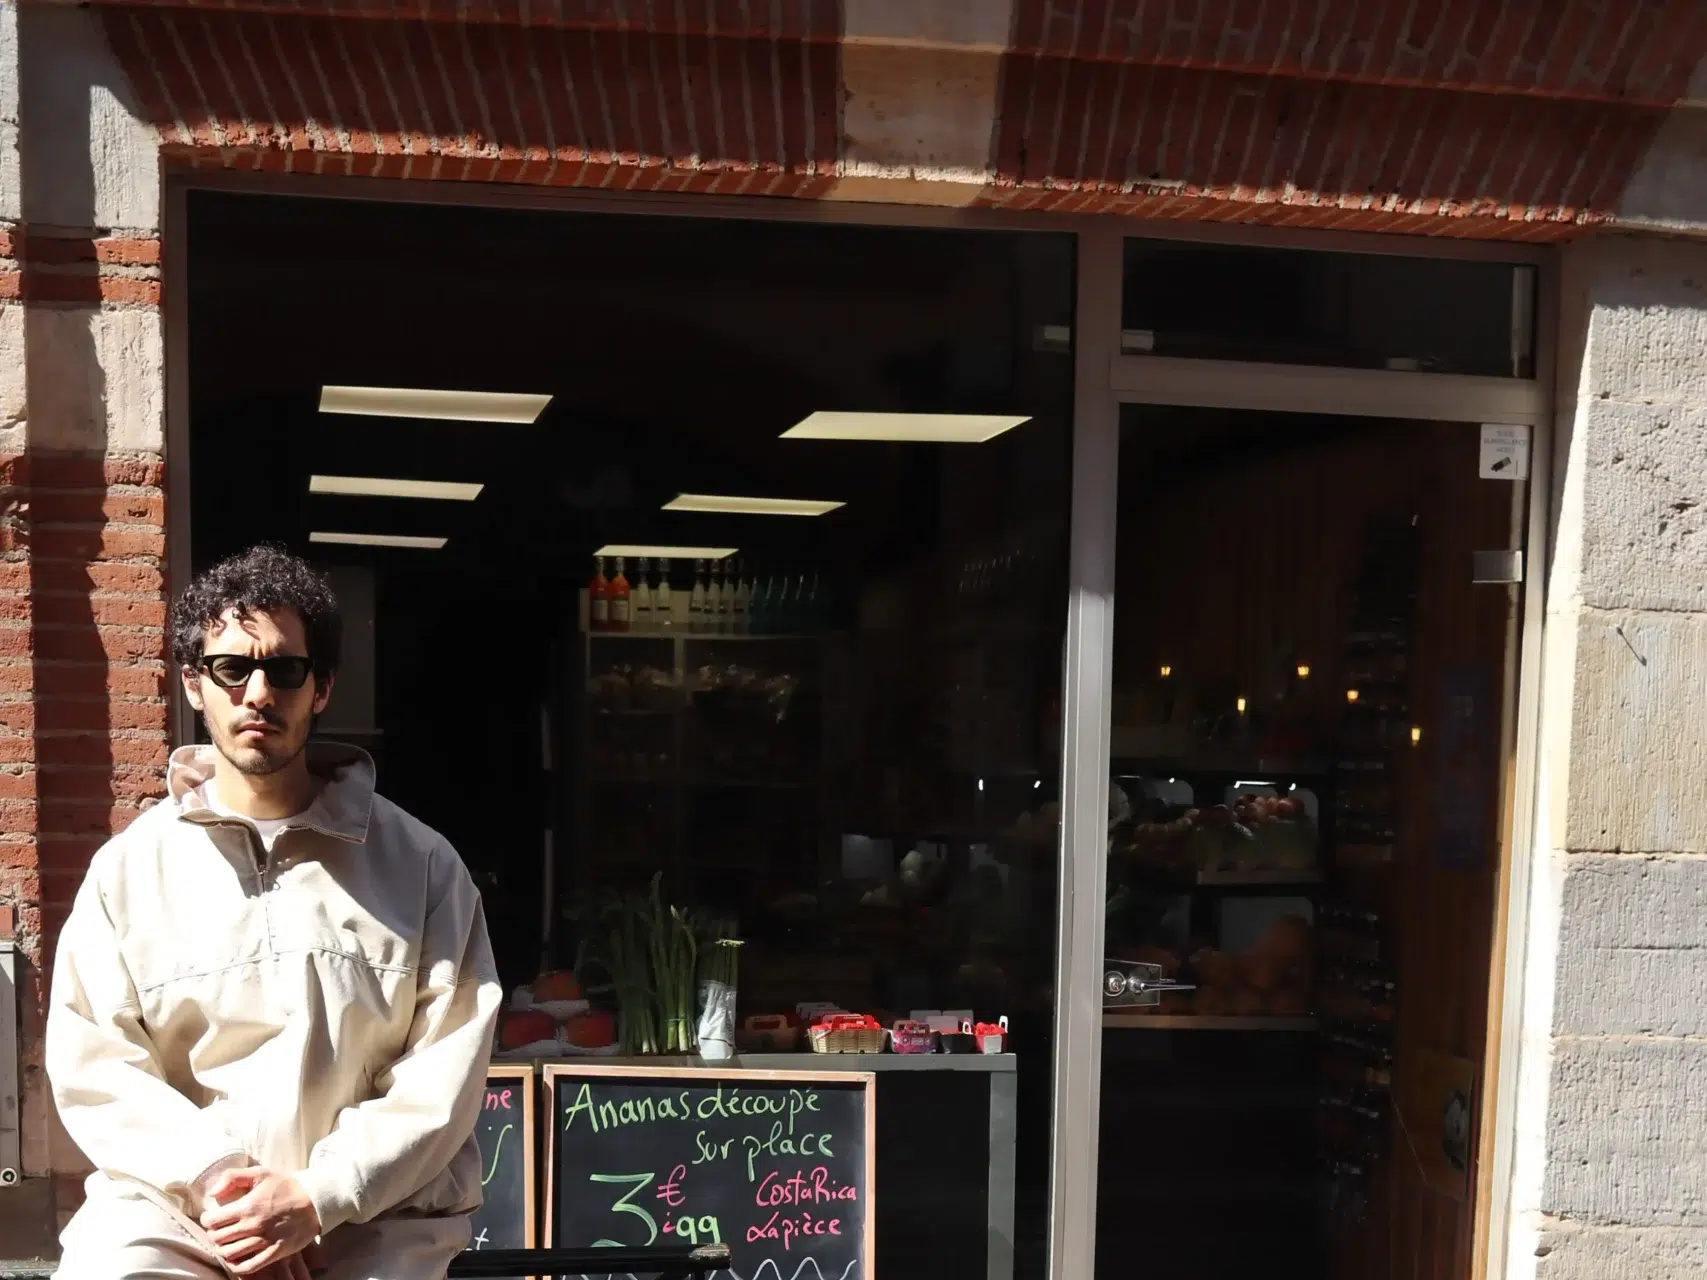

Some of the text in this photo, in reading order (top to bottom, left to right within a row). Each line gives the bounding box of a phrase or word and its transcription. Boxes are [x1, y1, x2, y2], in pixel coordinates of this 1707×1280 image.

[564, 1081, 821, 1135] Ananas découpé
[743, 1120, 835, 1182] place
